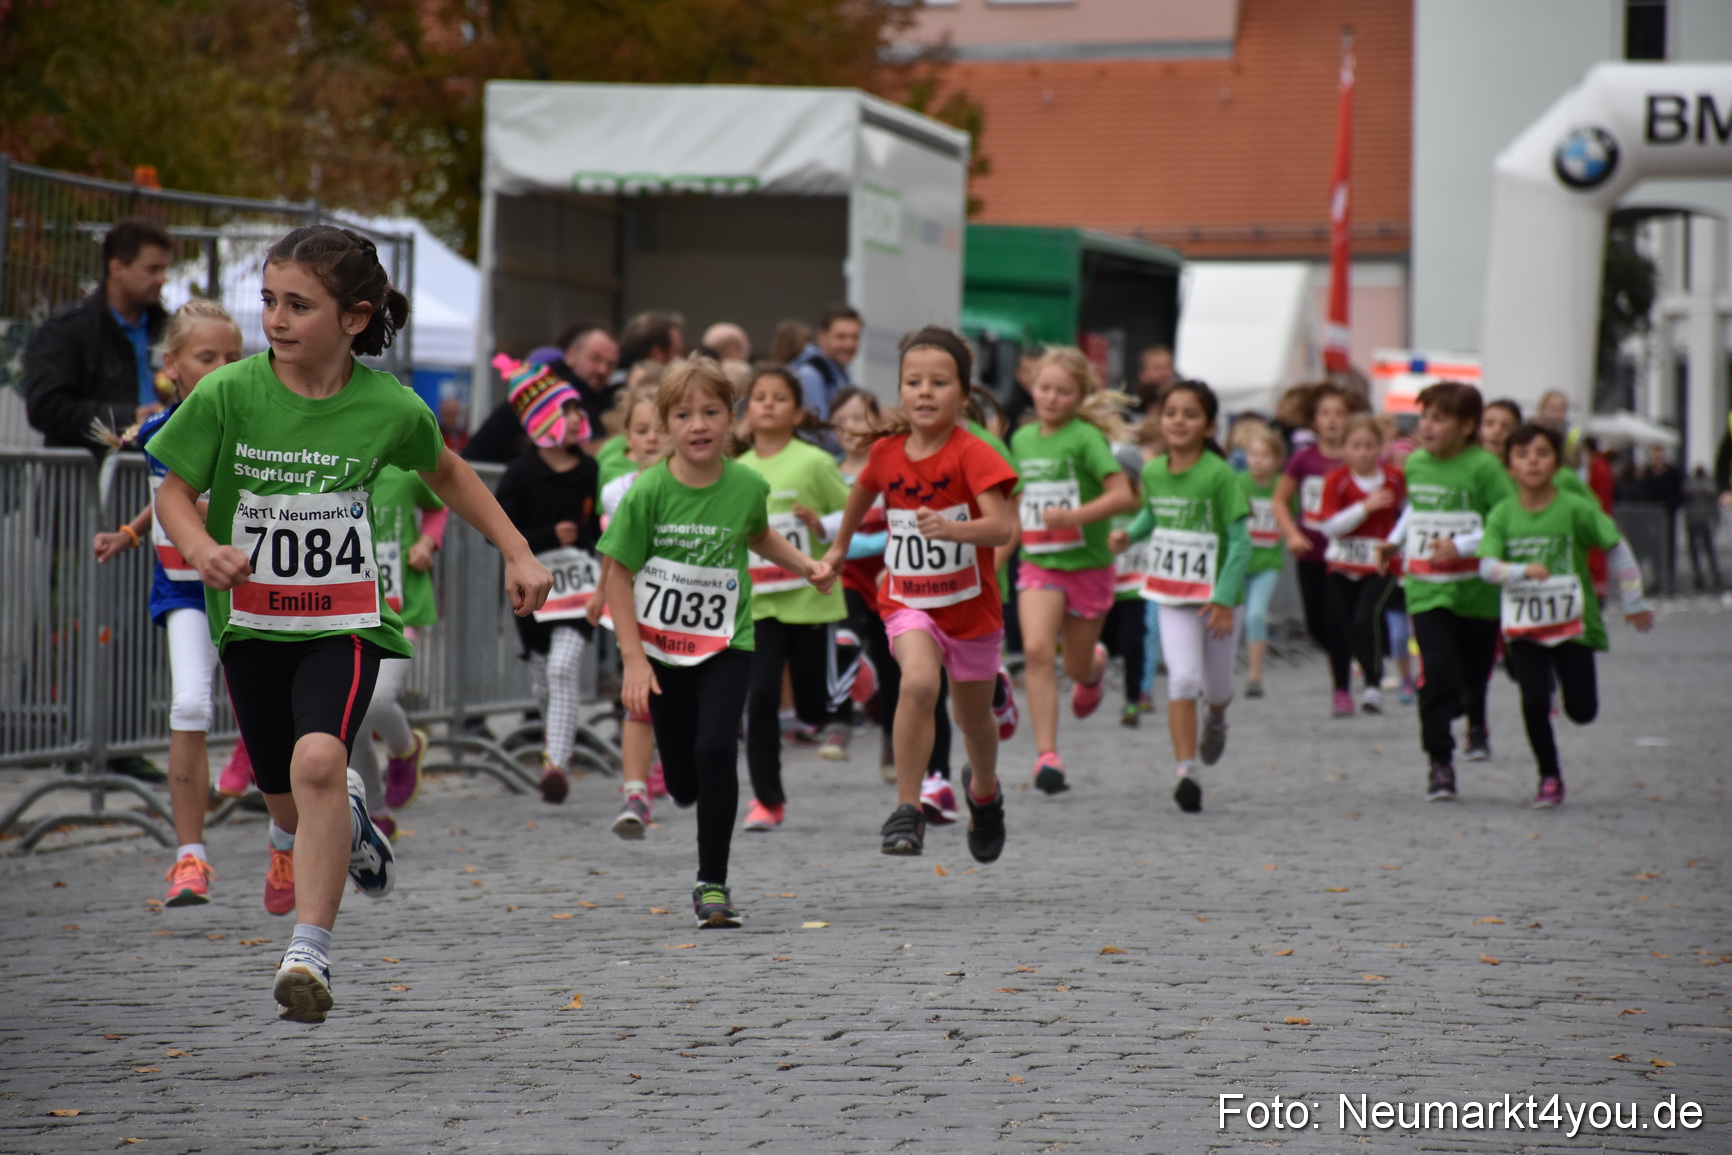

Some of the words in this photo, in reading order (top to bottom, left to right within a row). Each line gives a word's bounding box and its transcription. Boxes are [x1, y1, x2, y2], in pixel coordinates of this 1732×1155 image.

[235, 442, 340, 467] Neumarkter
[233, 463, 317, 488] Stadtlauf
[237, 502, 276, 520] PARTL
[278, 506, 349, 521] Neumarkt
[244, 525, 366, 578] 7084
[1152, 547, 1208, 579] 7414
[364, 570, 371, 579] K
[552, 563, 597, 594] 064
[671, 574, 722, 590] Neumarkt
[902, 579, 957, 595] Marlene
[268, 591, 332, 611] Emilia
[642, 581, 727, 630] 7033
[1512, 595, 1575, 623] 7017
[655, 634, 696, 653] Marie
